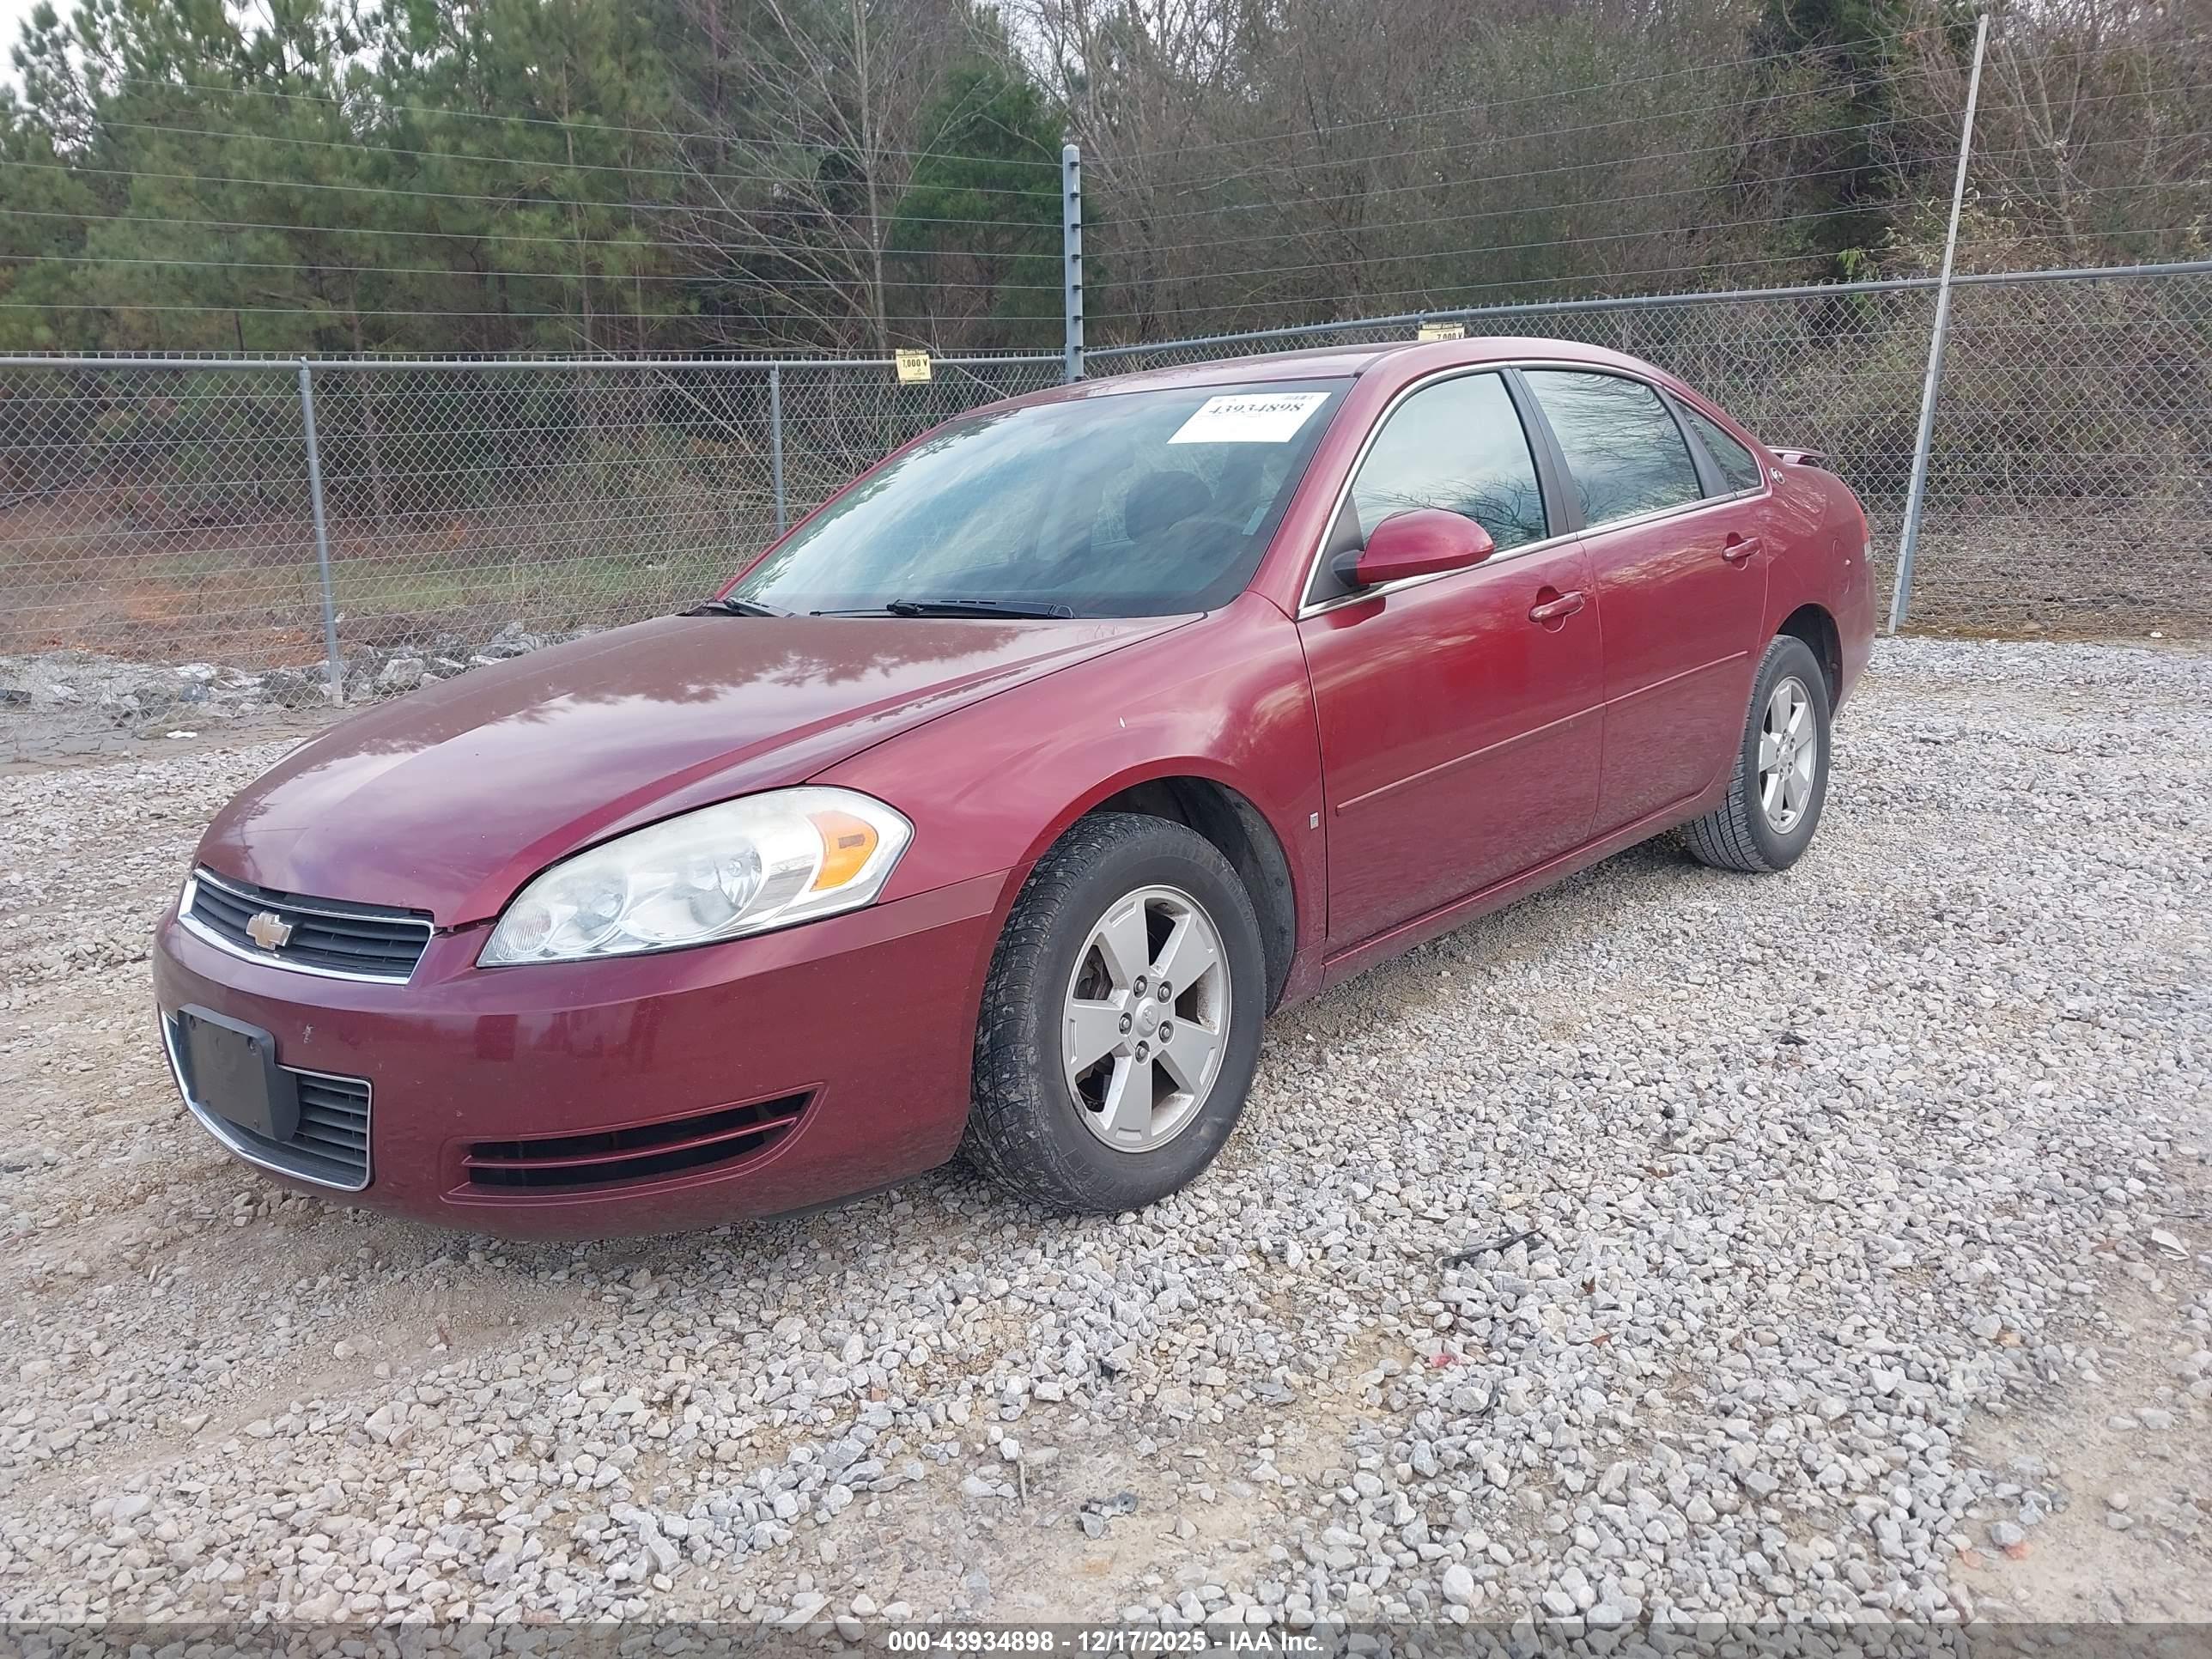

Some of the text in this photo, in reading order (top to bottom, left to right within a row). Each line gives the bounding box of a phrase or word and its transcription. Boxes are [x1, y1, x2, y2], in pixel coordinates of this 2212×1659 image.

[1437, 332, 1456, 341] 7000
[902, 358, 927, 368] 7,000 V
[1208, 402, 1304, 415] 43934898
